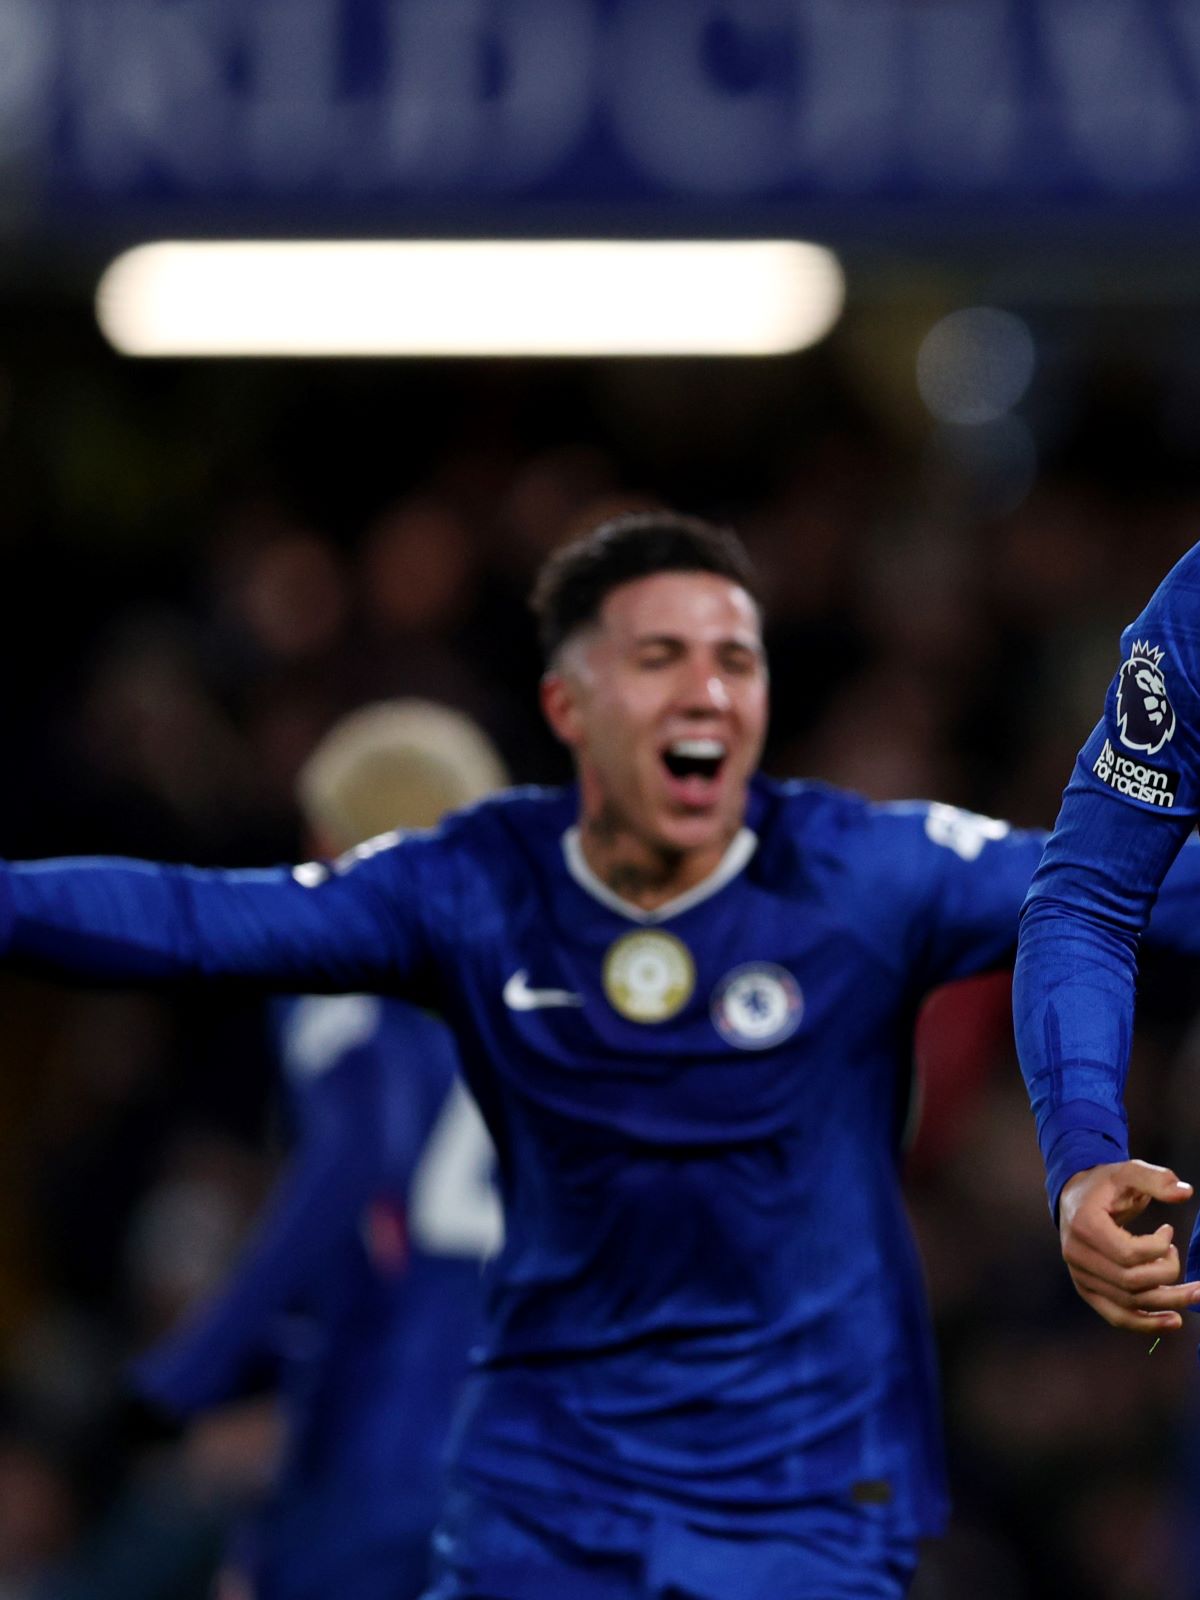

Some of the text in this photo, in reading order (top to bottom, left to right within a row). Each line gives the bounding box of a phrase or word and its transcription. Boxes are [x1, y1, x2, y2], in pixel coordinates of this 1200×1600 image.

[0, 0, 595, 192] RLD
[1092, 756, 1174, 808] for racism
[1100, 738, 1169, 790] No room
